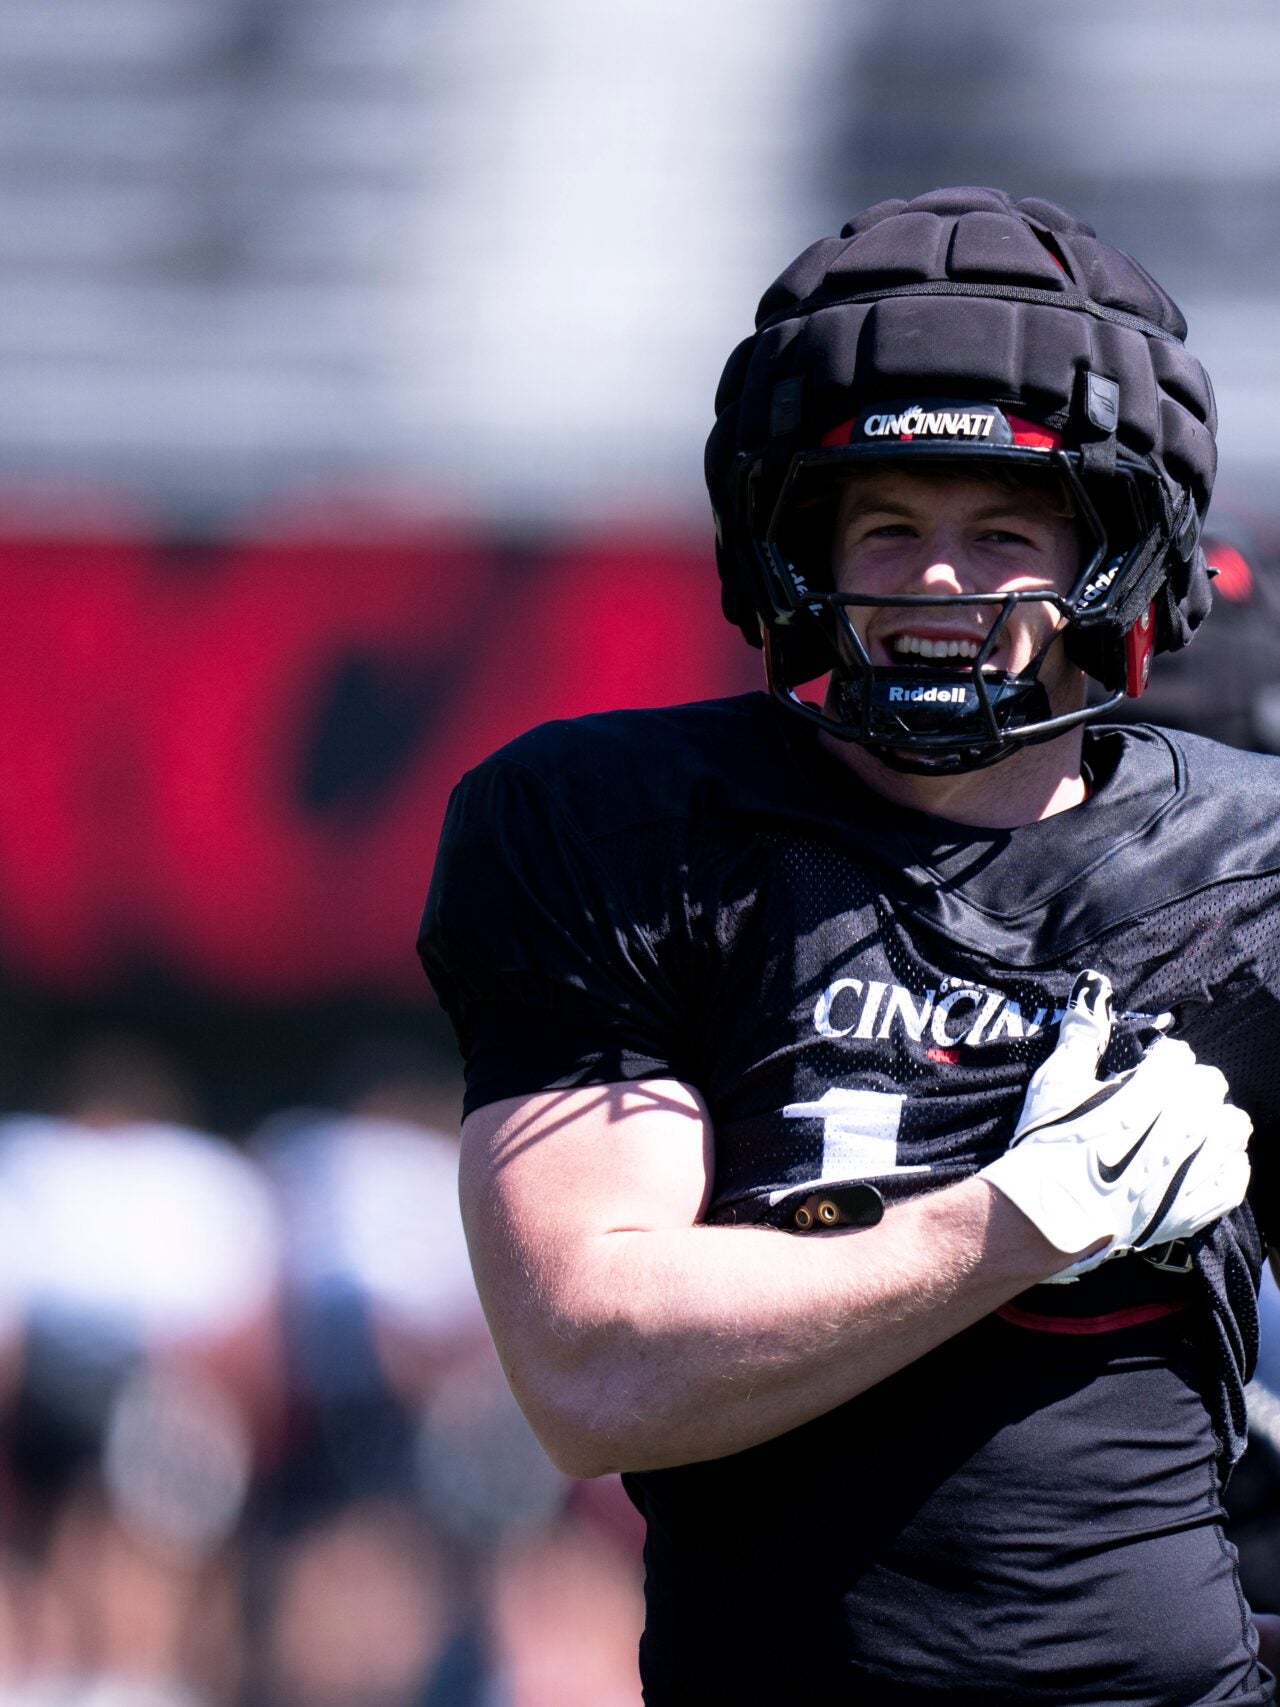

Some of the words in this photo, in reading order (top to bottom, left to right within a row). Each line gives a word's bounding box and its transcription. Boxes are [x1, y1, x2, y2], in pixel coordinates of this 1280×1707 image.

[863, 412, 995, 437] CINCINNATI
[888, 686, 966, 703] Riddell
[769, 1086, 931, 1206] 1
